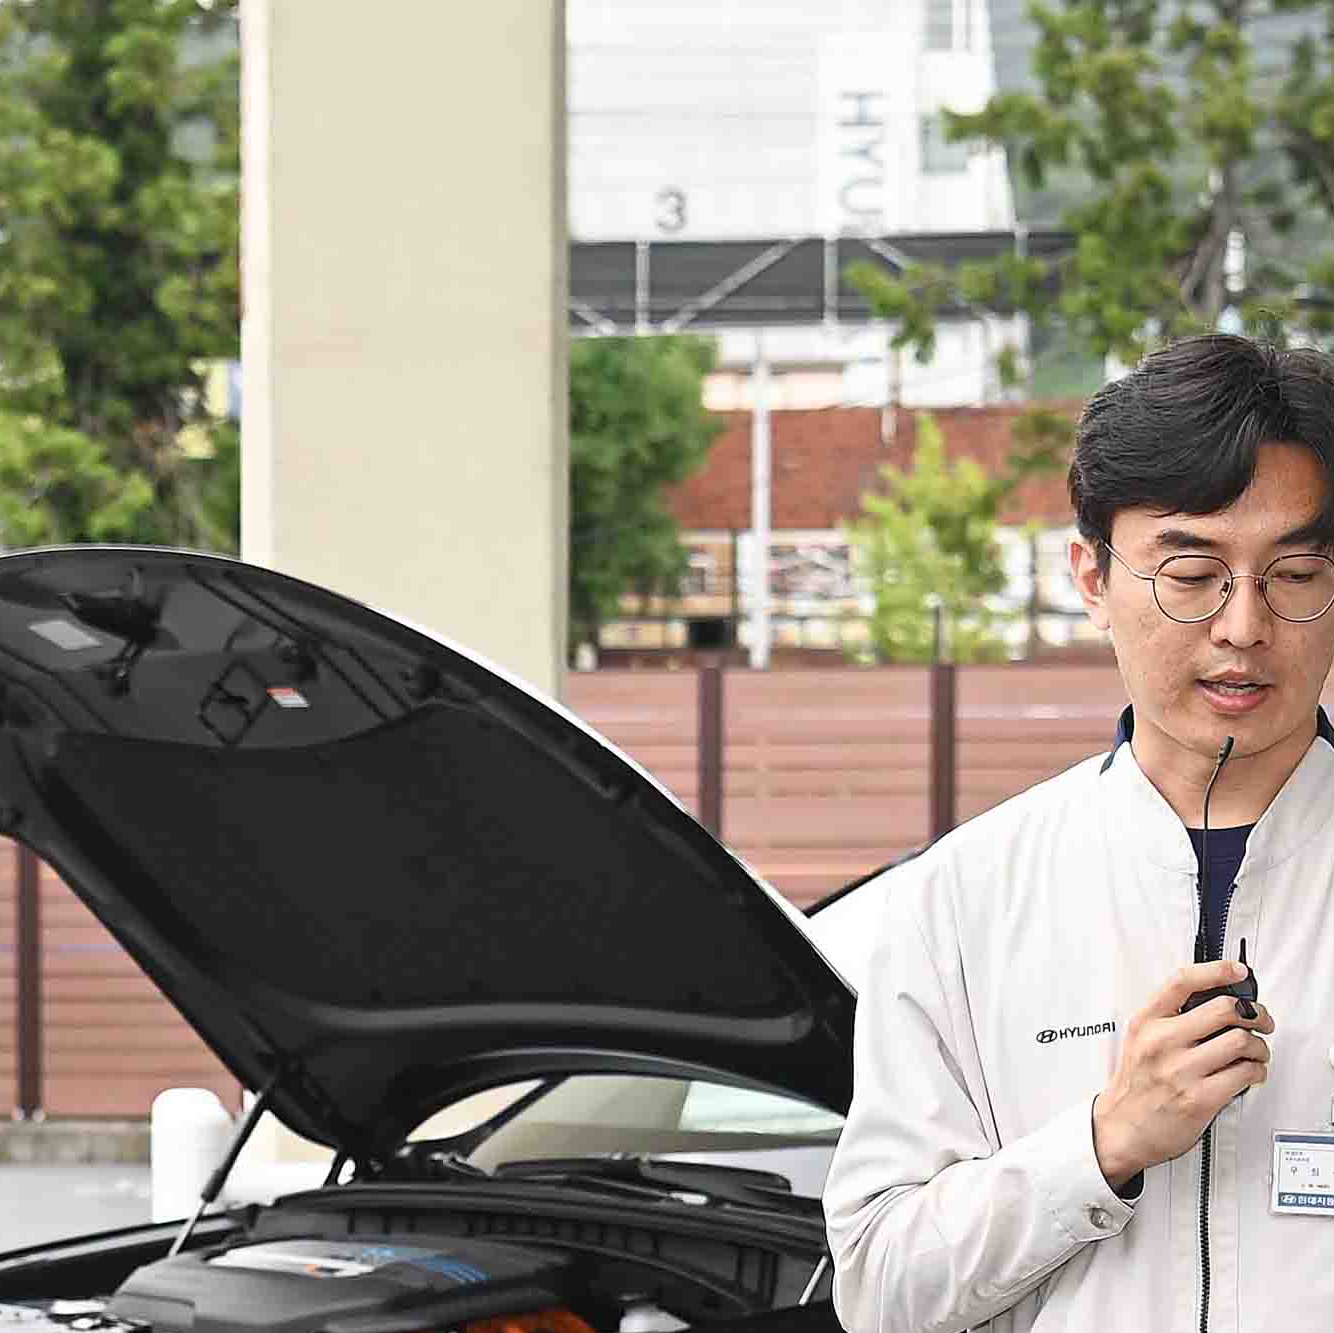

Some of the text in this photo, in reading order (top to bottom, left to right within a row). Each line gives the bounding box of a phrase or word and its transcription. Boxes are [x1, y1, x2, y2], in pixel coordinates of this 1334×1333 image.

[838, 91, 884, 238] HYU
[656, 187, 686, 233] 3
[1059, 1021, 1116, 1039] HYUNDAI
